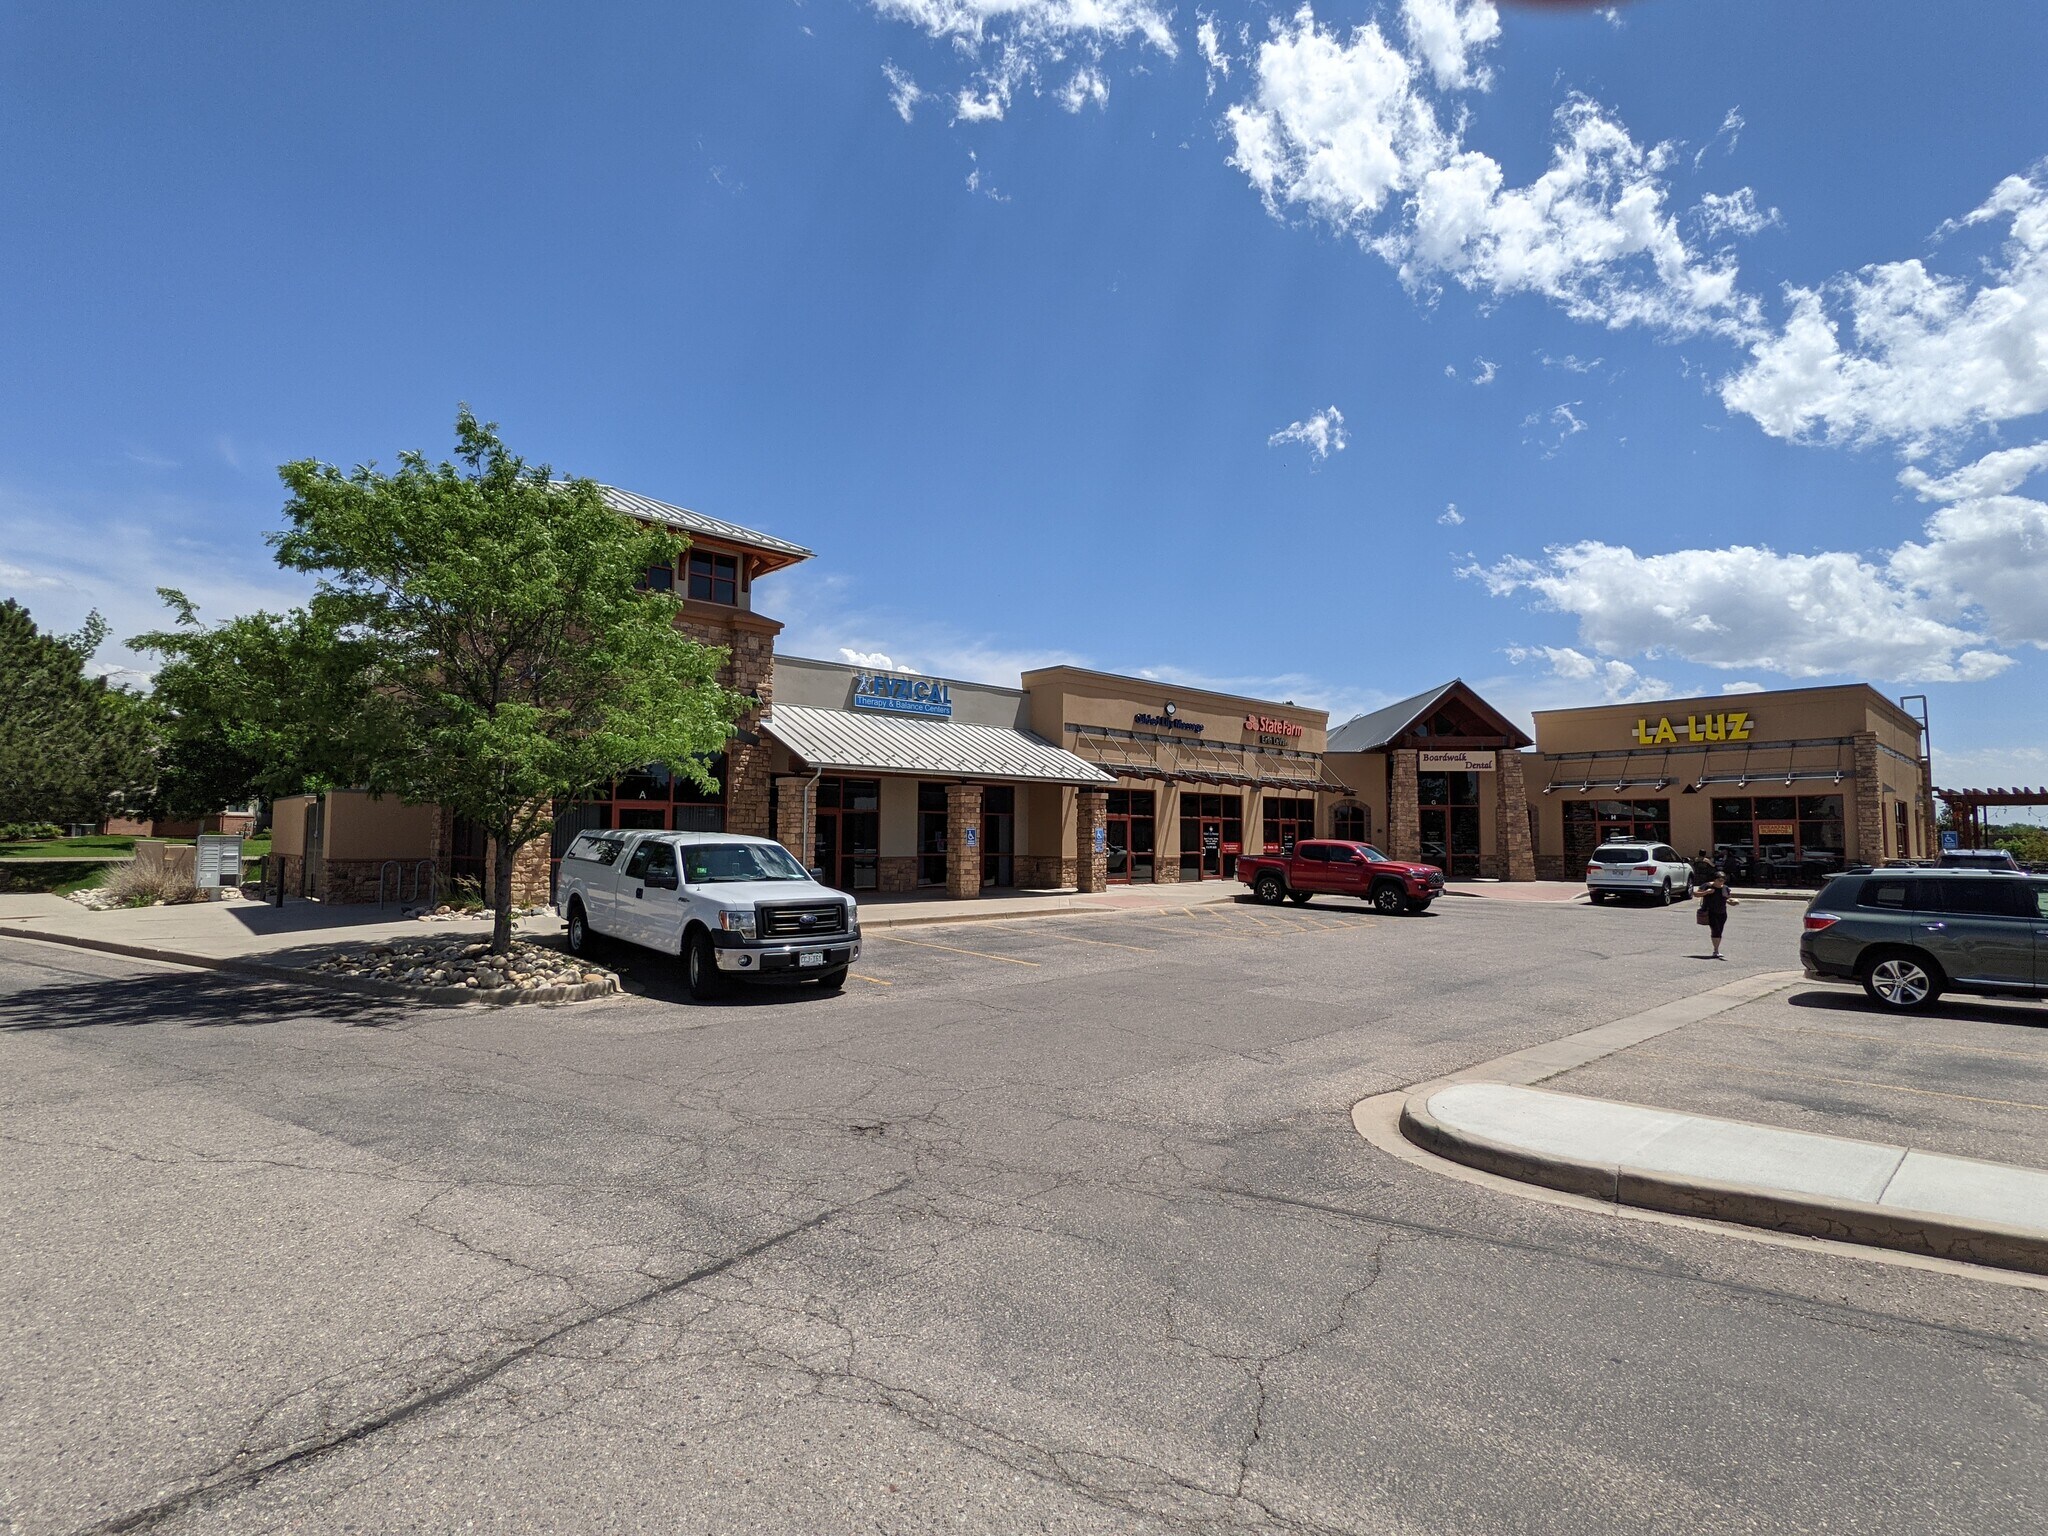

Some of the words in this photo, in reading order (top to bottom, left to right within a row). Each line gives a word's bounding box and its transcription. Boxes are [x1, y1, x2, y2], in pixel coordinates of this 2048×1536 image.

[873, 676, 951, 704] FYZICAL
[857, 696, 886, 708] Therapy
[895, 700, 924, 711] Balance
[924, 705, 951, 715] Centers
[1638, 717, 1678, 744] LA
[1687, 712, 1750, 742] LUZ
[1423, 753, 1467, 762] Boardwalk
[1465, 760, 1492, 769] Dental
[639, 790, 647, 799] A
